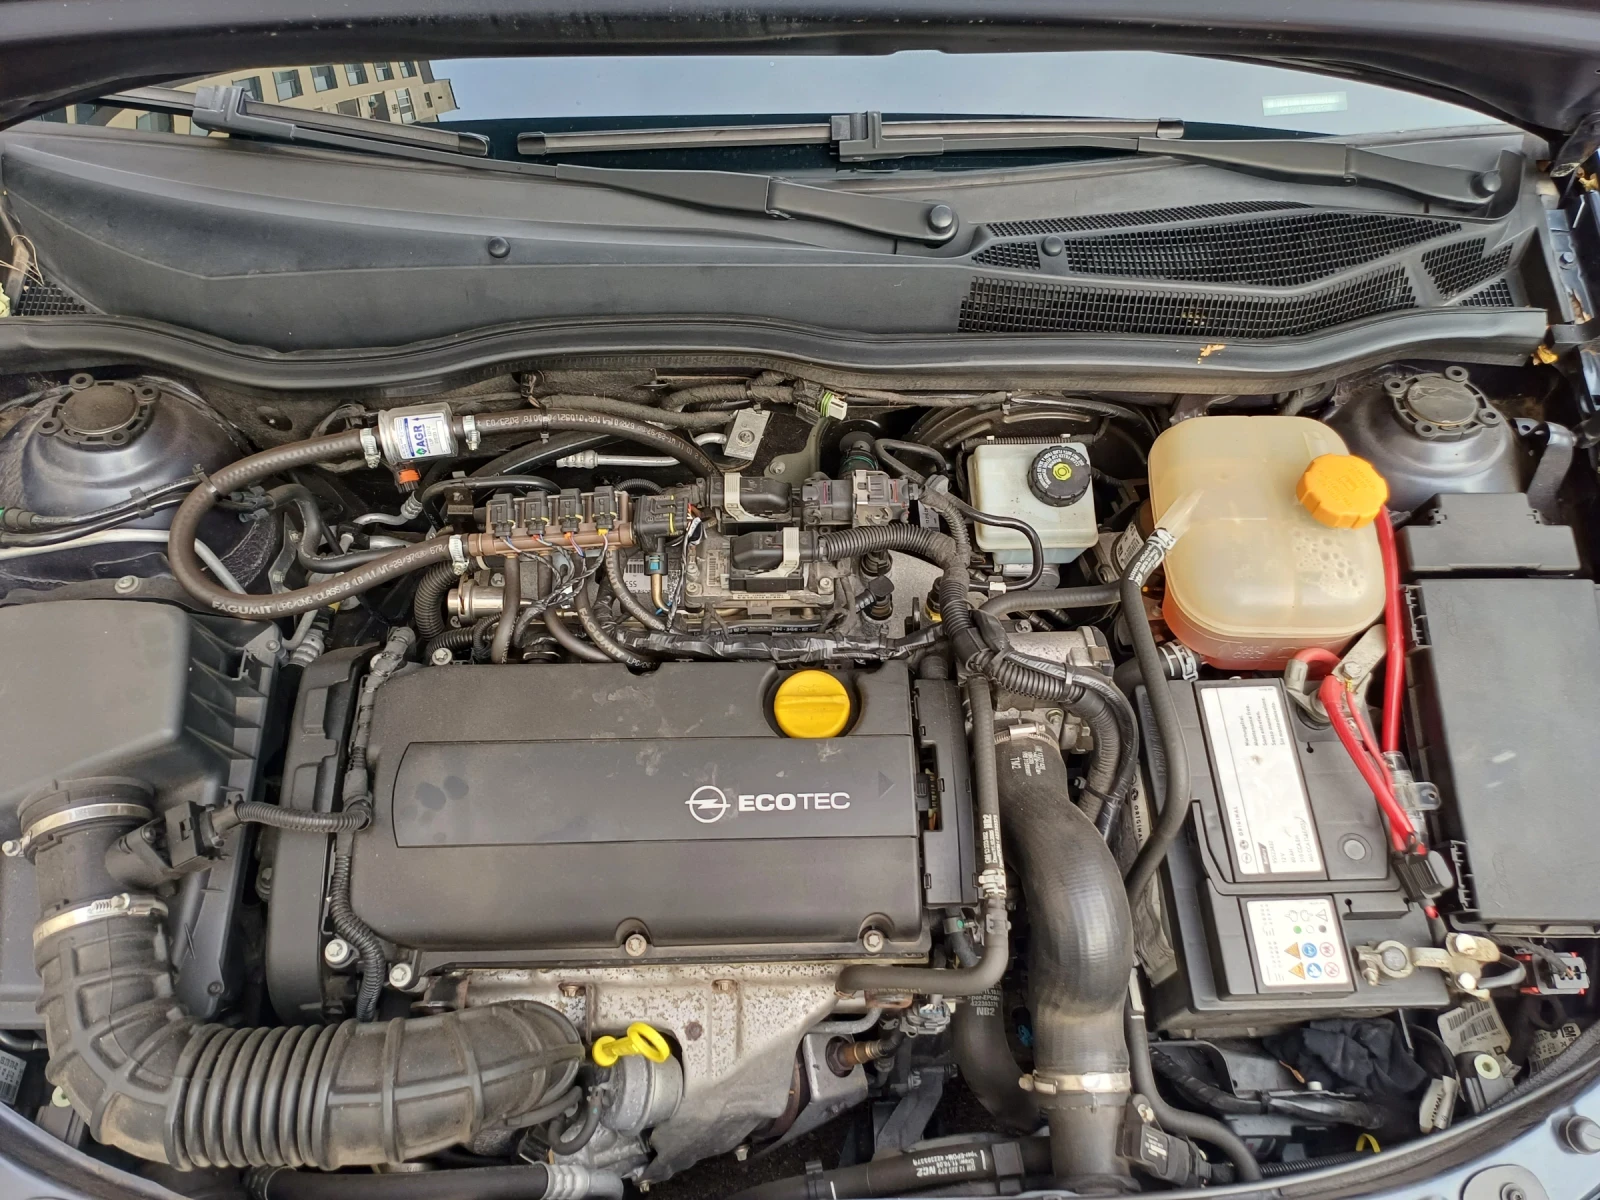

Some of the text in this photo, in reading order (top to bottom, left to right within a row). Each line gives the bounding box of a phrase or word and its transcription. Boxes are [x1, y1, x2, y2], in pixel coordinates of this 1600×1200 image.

[413, 425, 426, 447] AGR
[211, 601, 272, 615] FAGUMIT
[277, 596, 314, 612] LPG/CNG
[315, 585, 341, 601] CLASS
[344, 582, 350, 591] 2
[579, 607, 624, 658] FAGUMIT
[738, 792, 850, 812] ECOTEC
[1133, 805, 1144, 843] ORIGINAL
[1233, 806, 1244, 836] ORIGINAL
[976, 1007, 995, 1016] NB2
[916, 1165, 936, 1177] NC2
